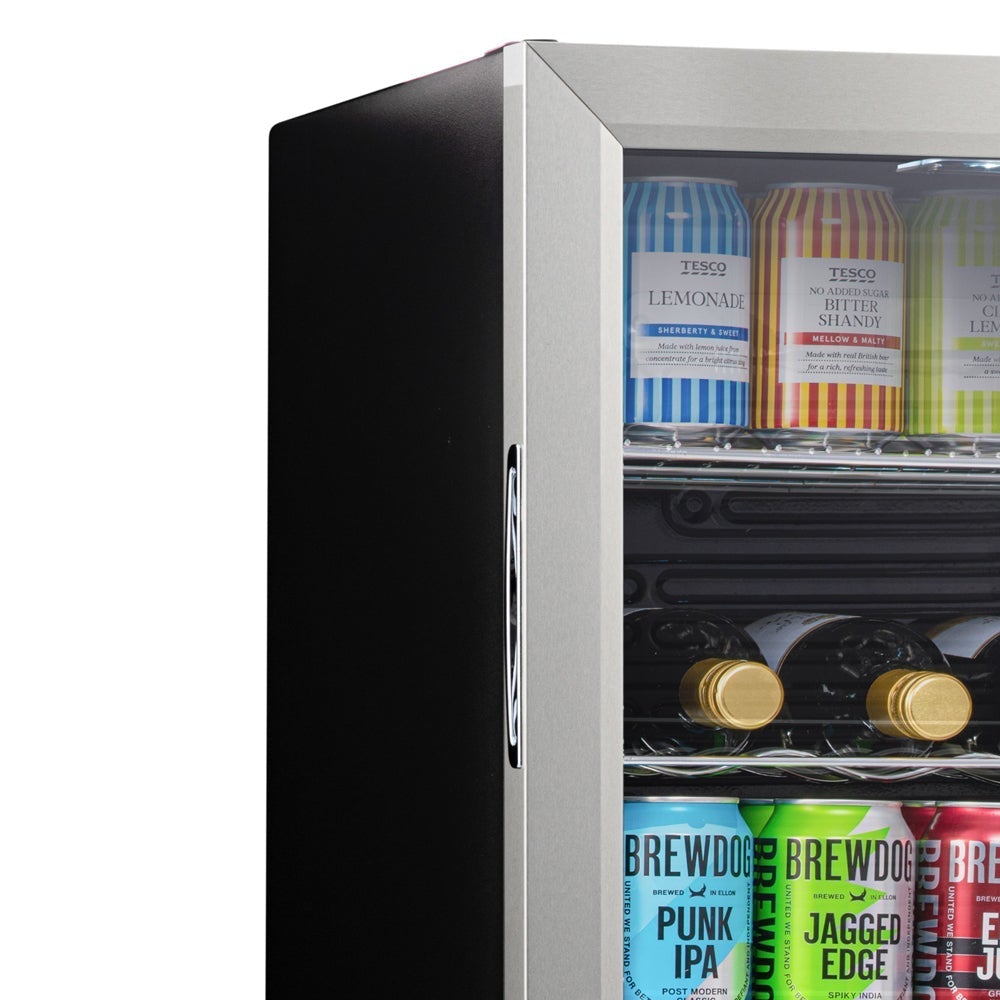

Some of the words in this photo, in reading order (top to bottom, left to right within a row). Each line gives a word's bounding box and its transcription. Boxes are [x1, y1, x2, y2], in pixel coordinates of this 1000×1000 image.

[680, 260, 727, 272] TESCO
[829, 268, 877, 279] TESCO
[809, 287, 825, 296] NO
[827, 288, 861, 297] ADDED
[862, 289, 890, 299] SUGAR
[648, 290, 745, 310] LEMONADE
[825, 299, 879, 313] BITTER
[818, 313, 883, 329] SHANDY
[658, 327, 708, 336] SHERBERTY
[711, 328, 716, 336] &
[719, 329, 740, 337] SWEET
[812, 335, 849, 344] MELLOW
[861, 337, 886, 345] MALTY
[657, 343, 677, 351] Made
[686, 355, 698, 364] for
[843, 352, 858, 360] real
[806, 363, 819, 372] for
[624, 834, 751, 878] BREWDOG
[785, 838, 912, 882] BREWDOG
[652, 889, 685, 897] BREWED
[657, 906, 733, 941] PUNK
[803, 912, 901, 945] JAGGED
[674, 944, 719, 979] IPA
[821, 948, 888, 980] EDGE
[662, 988, 688, 996] POST
[691, 988, 728, 996] MODERN
[828, 991, 857, 999] SPIKY
[859, 991, 882, 999] INDIA
